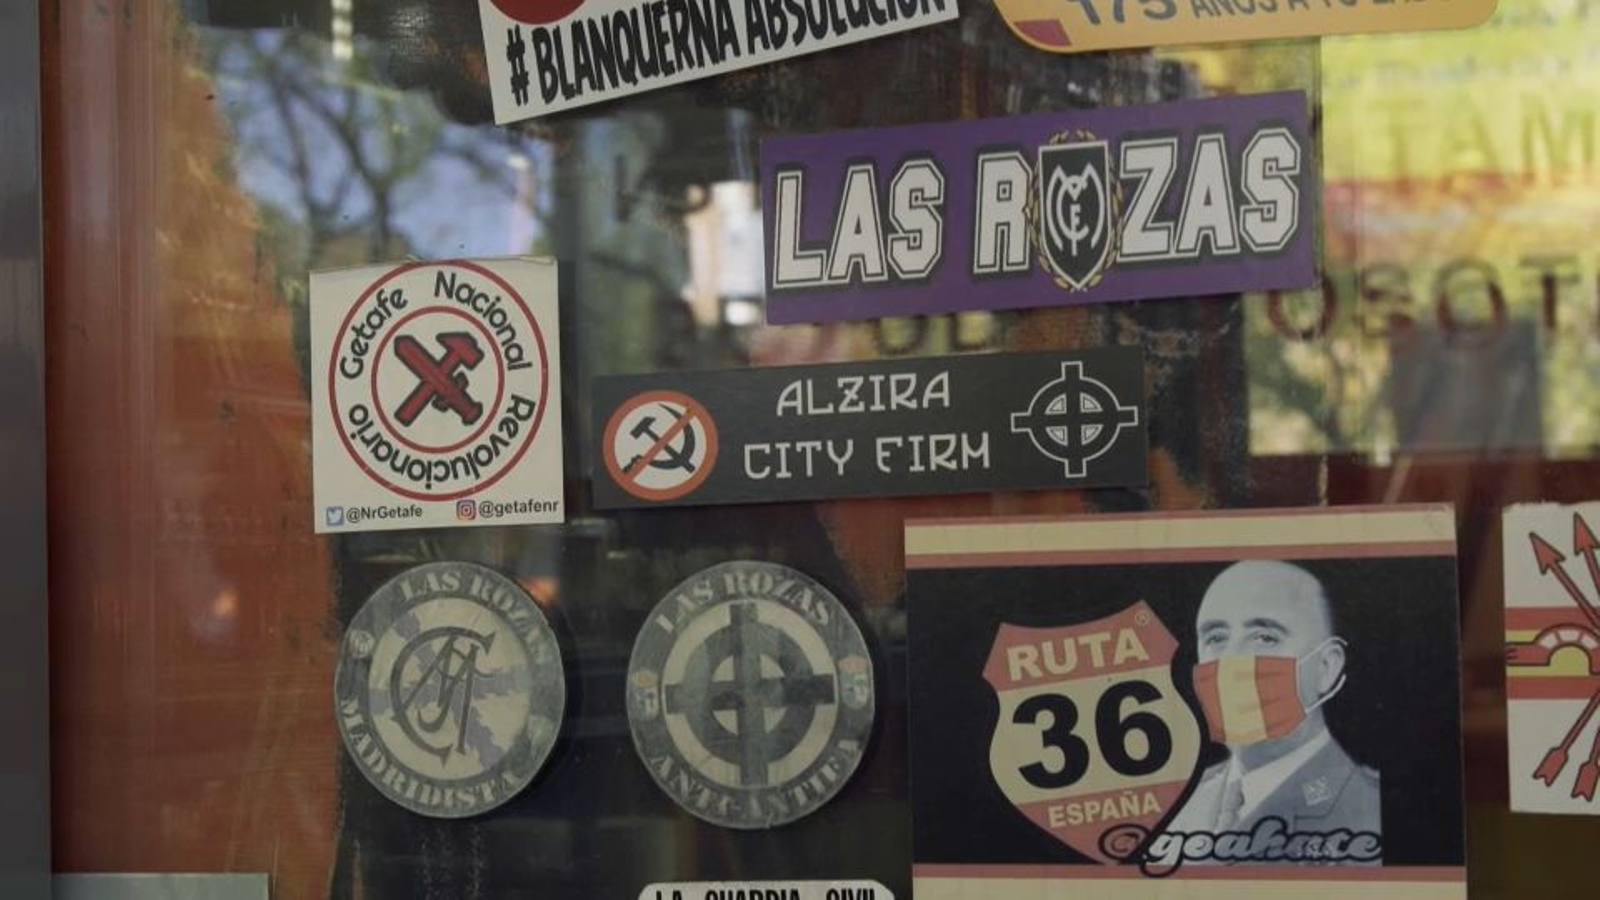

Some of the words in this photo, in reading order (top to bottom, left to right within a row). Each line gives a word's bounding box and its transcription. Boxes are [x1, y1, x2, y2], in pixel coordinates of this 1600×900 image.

[773, 160, 944, 289] LAS
[340, 288, 408, 380] Getafe
[434, 271, 533, 371] Nacional
[776, 371, 951, 416] ALZIRA
[349, 394, 536, 490] Revolucionario
[744, 439, 854, 480] CITY
[875, 433, 991, 474] FIRM
[346, 506, 423, 524] @NrGetafe
[478, 499, 559, 518] @getafenr
[400, 571, 461, 600] LAS
[656, 580, 713, 634] LAS
[723, 571, 830, 626] ROZAS
[1007, 628, 1150, 682] RUTA
[340, 694, 523, 809] MADRIDISTA
[1012, 680, 1173, 789] 36
[1048, 790, 1161, 829] ESPAÑA
